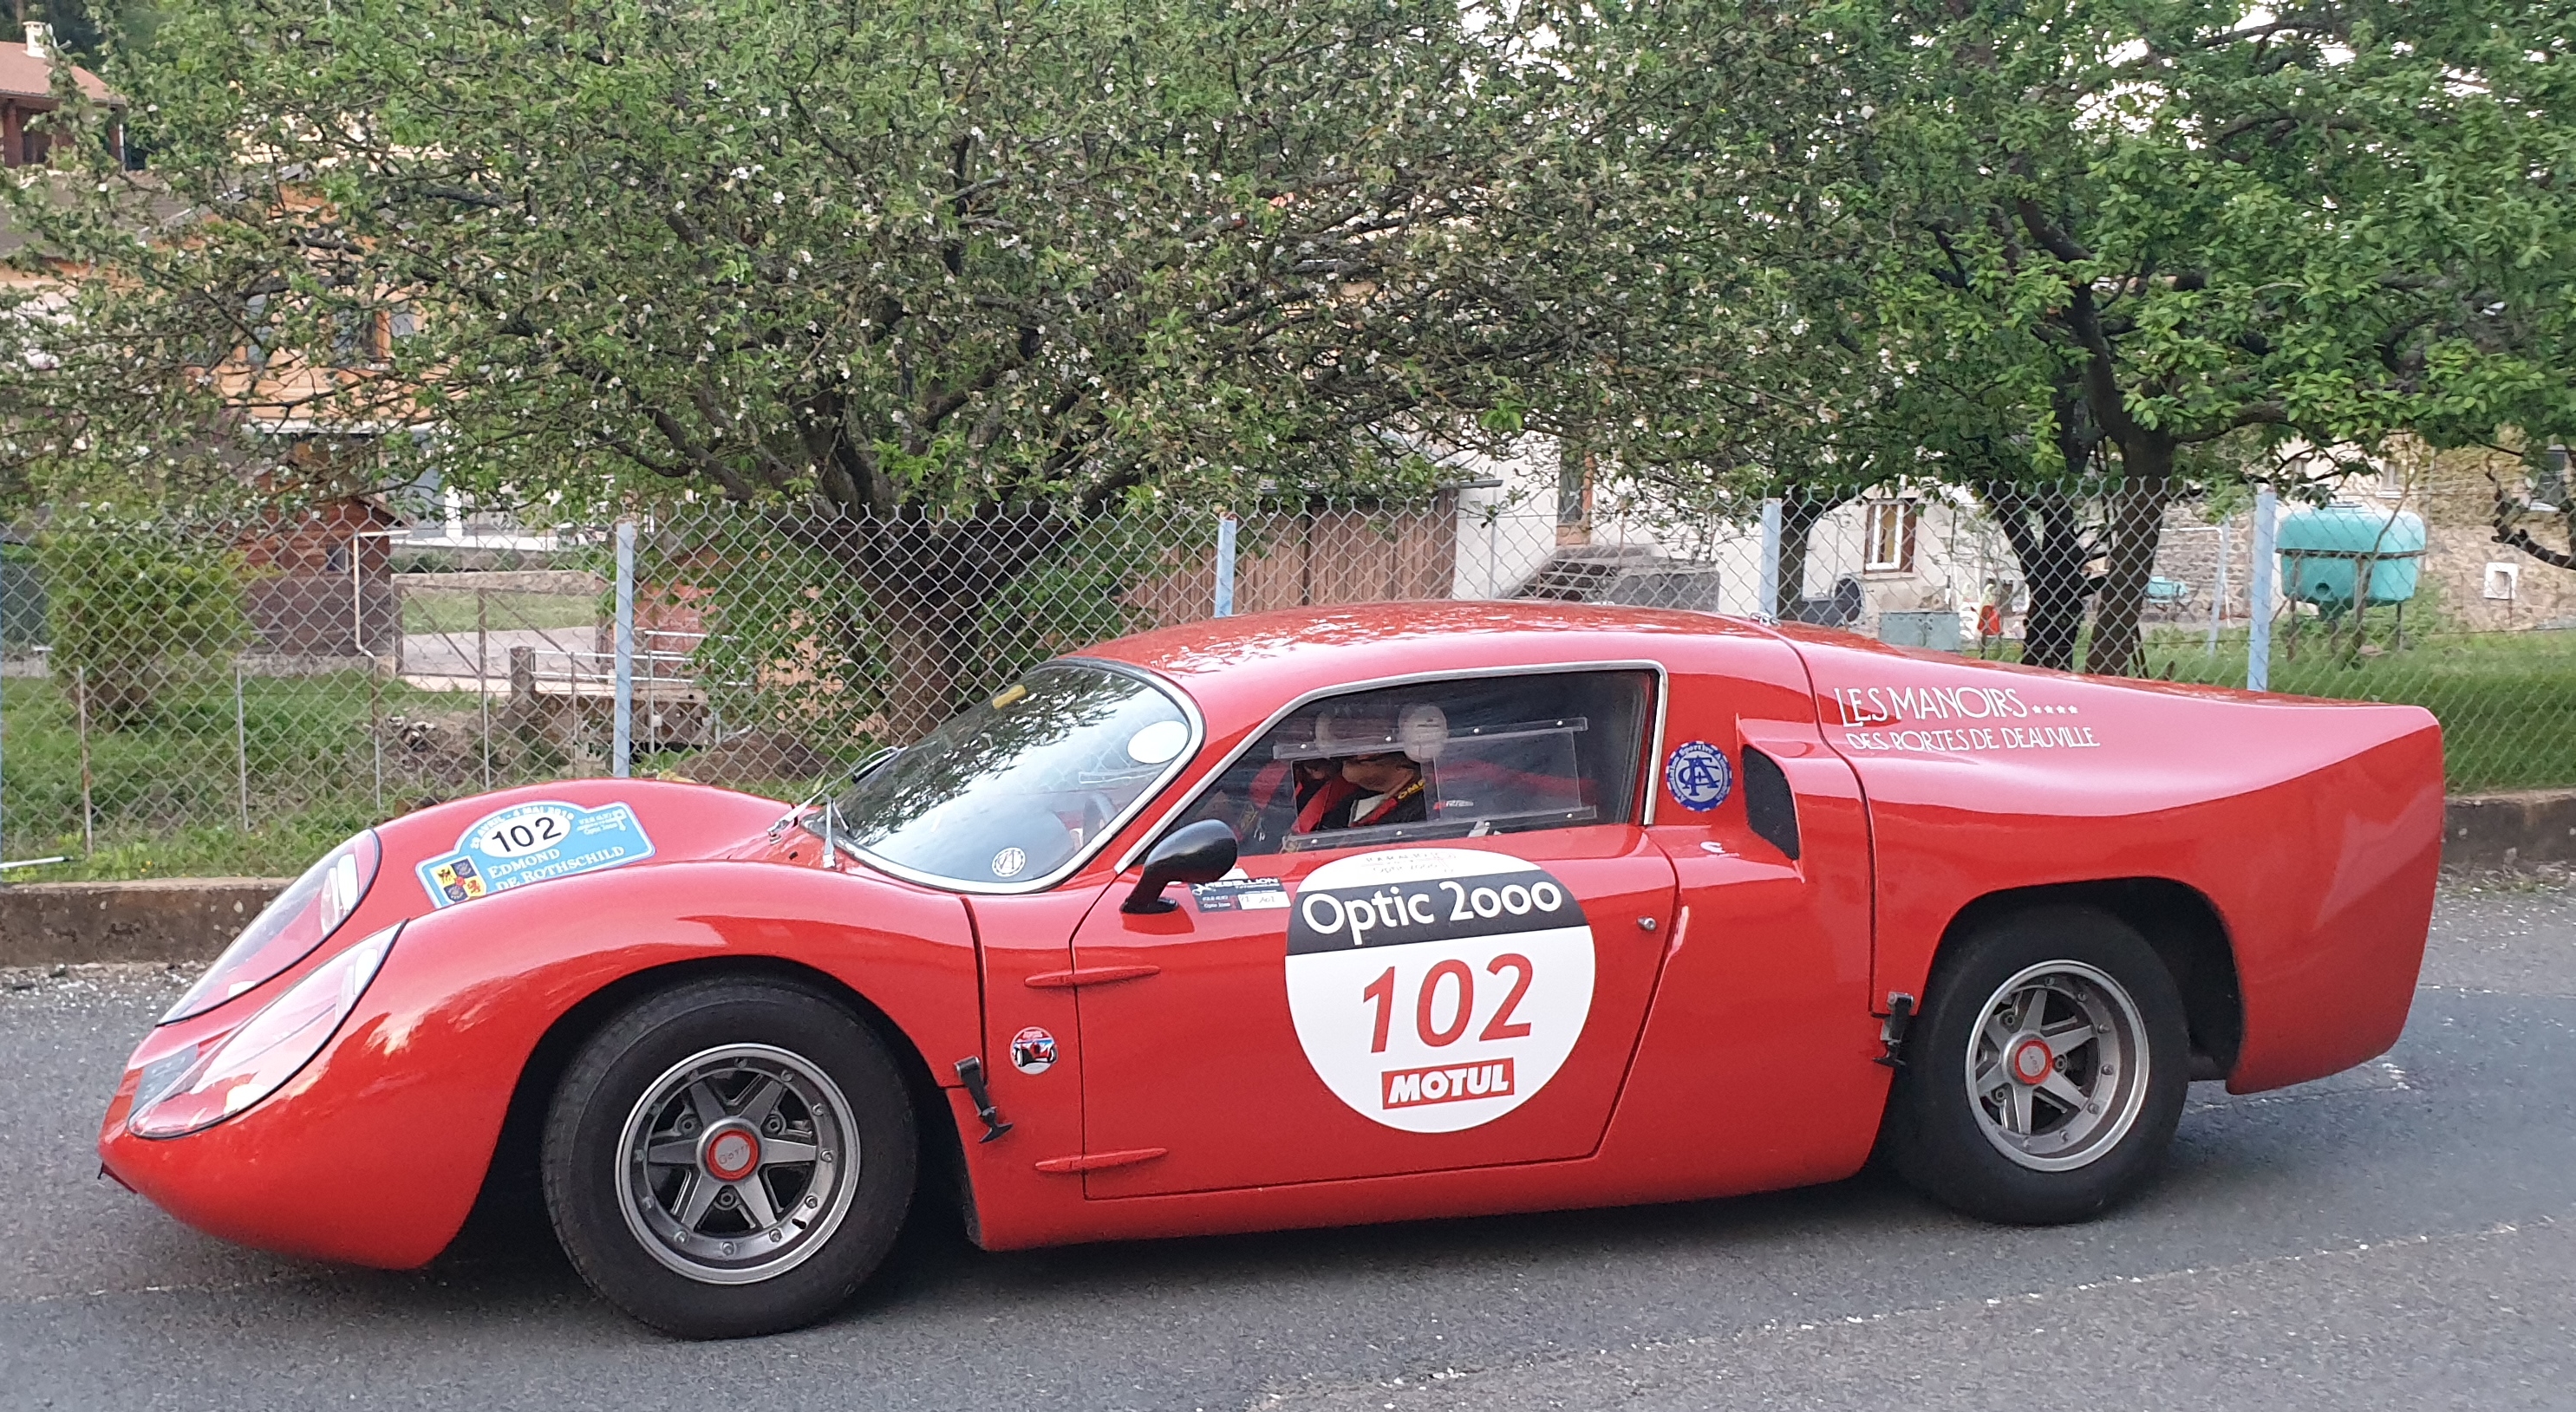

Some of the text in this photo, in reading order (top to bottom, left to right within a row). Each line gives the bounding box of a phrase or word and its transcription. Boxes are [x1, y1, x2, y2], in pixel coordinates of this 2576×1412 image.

[1834, 686, 2027, 727] LES MANOIRS
[1845, 726, 2101, 752] DES PORTES DE DEAUVILLE
[522, 805, 545, 816] MAI
[492, 817, 562, 852] 102
[487, 848, 561, 879] EDMOND
[495, 846, 625, 891] DE ROTHSCHILD
[1301, 881, 1562, 946] Optic 2000
[1363, 953, 1533, 1054] 102
[1387, 1063, 1510, 1103] MOTUL
